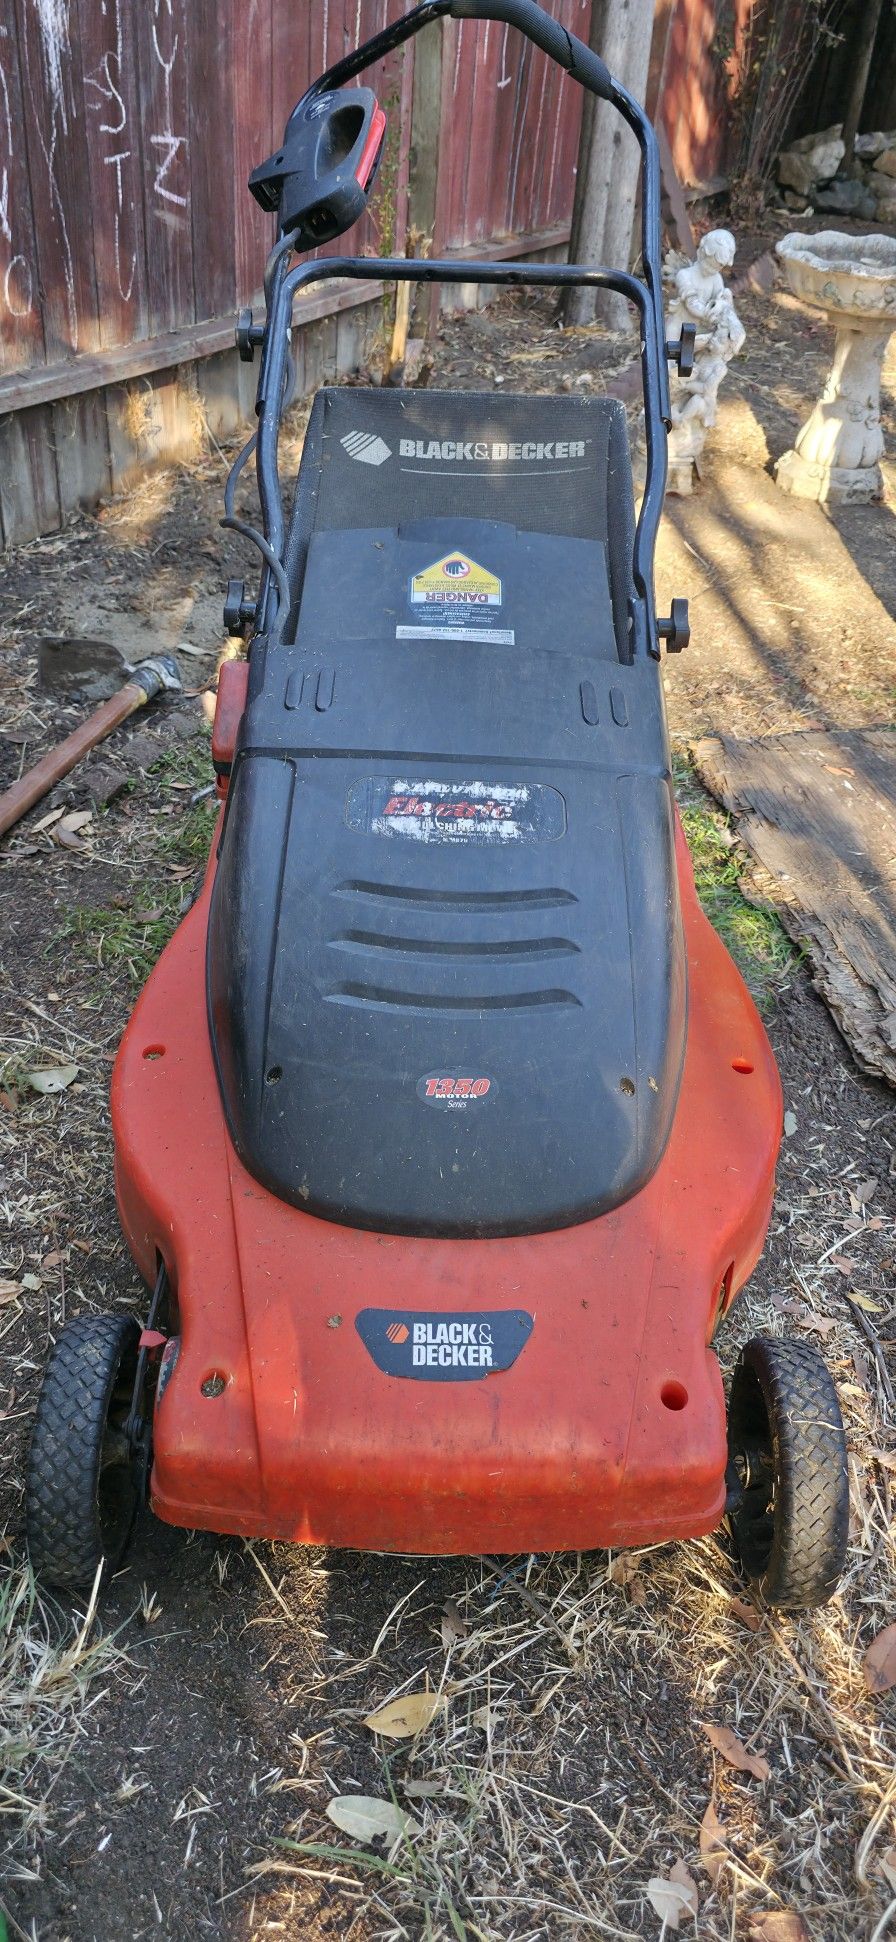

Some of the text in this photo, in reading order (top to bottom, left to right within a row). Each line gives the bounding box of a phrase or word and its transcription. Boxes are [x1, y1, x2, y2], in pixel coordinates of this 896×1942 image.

[399, 438, 585, 461] BLACK&DECKER
[426, 592, 489, 603] DANGER
[425, 1078, 491, 1096] 1350
[447, 1099, 467, 1108] Series
[412, 1345, 493, 1367] DECKER
